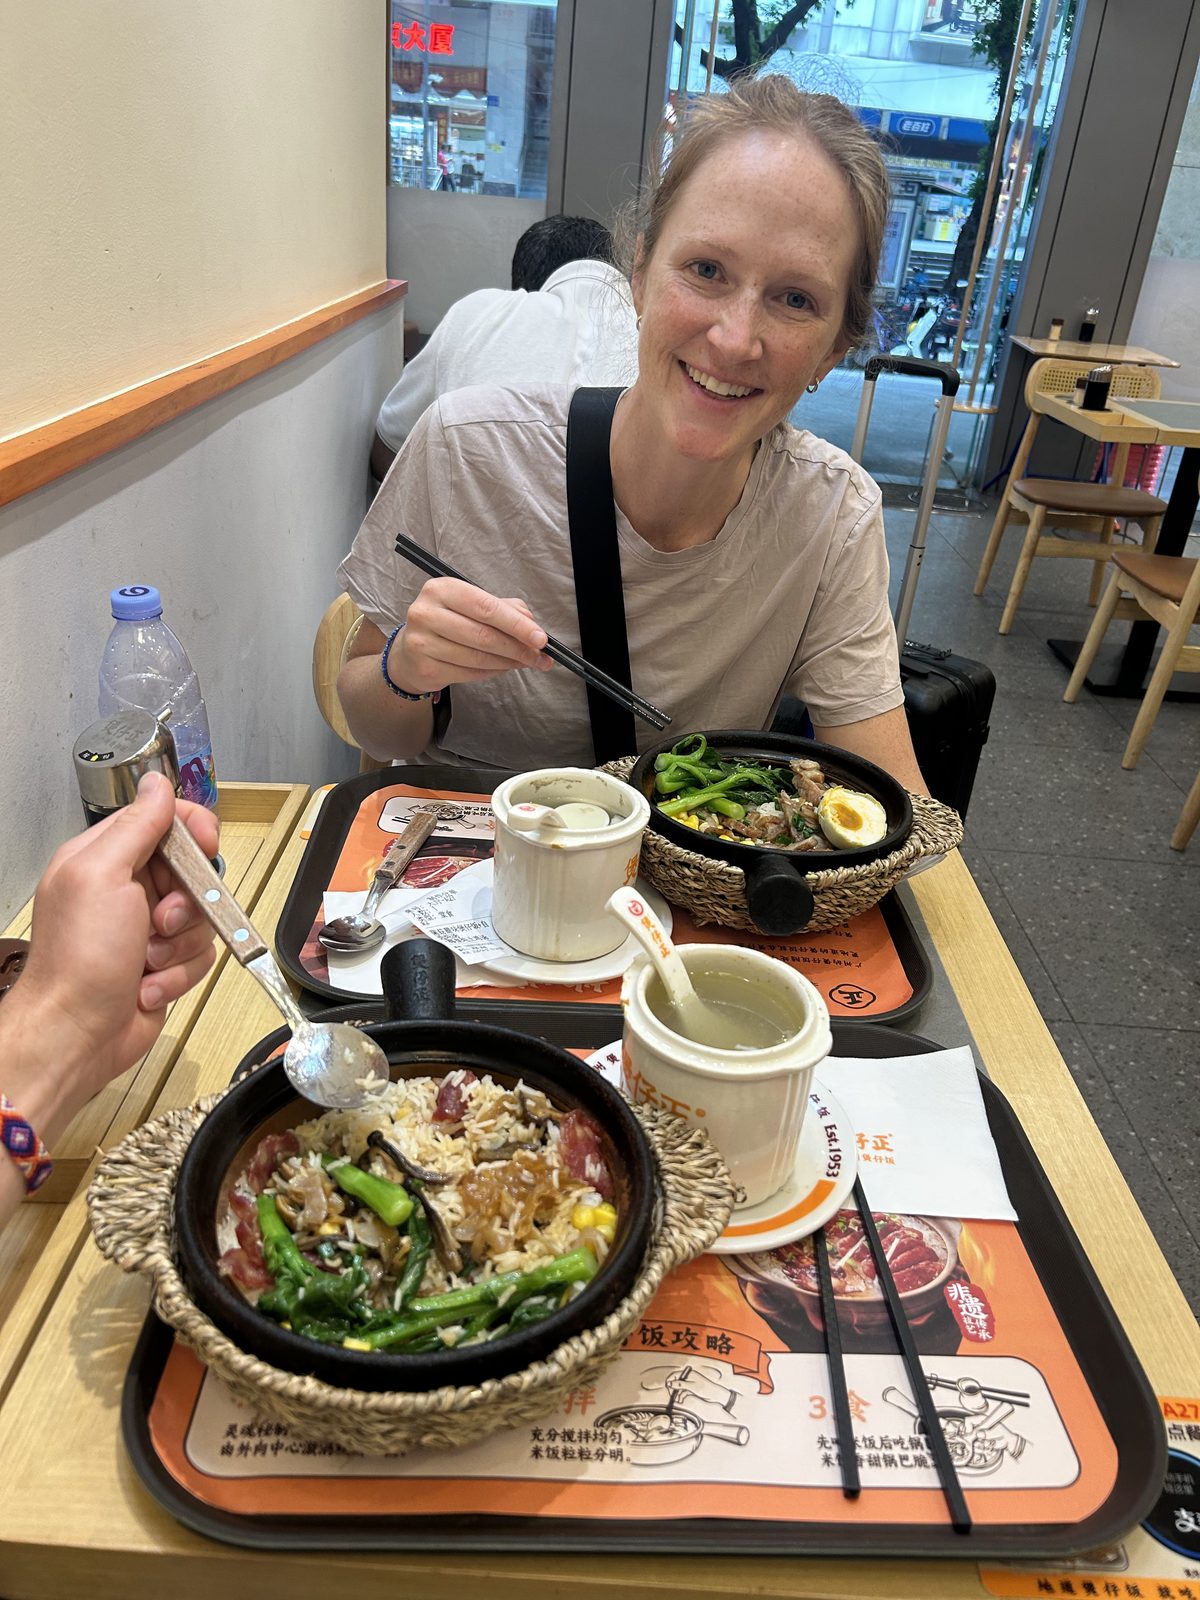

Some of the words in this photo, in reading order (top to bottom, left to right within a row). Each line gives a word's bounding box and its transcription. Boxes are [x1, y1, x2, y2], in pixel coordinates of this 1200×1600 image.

[621, 1324, 735, 1355] 饭攻略
[1163, 1402, 1199, 1420] A27
